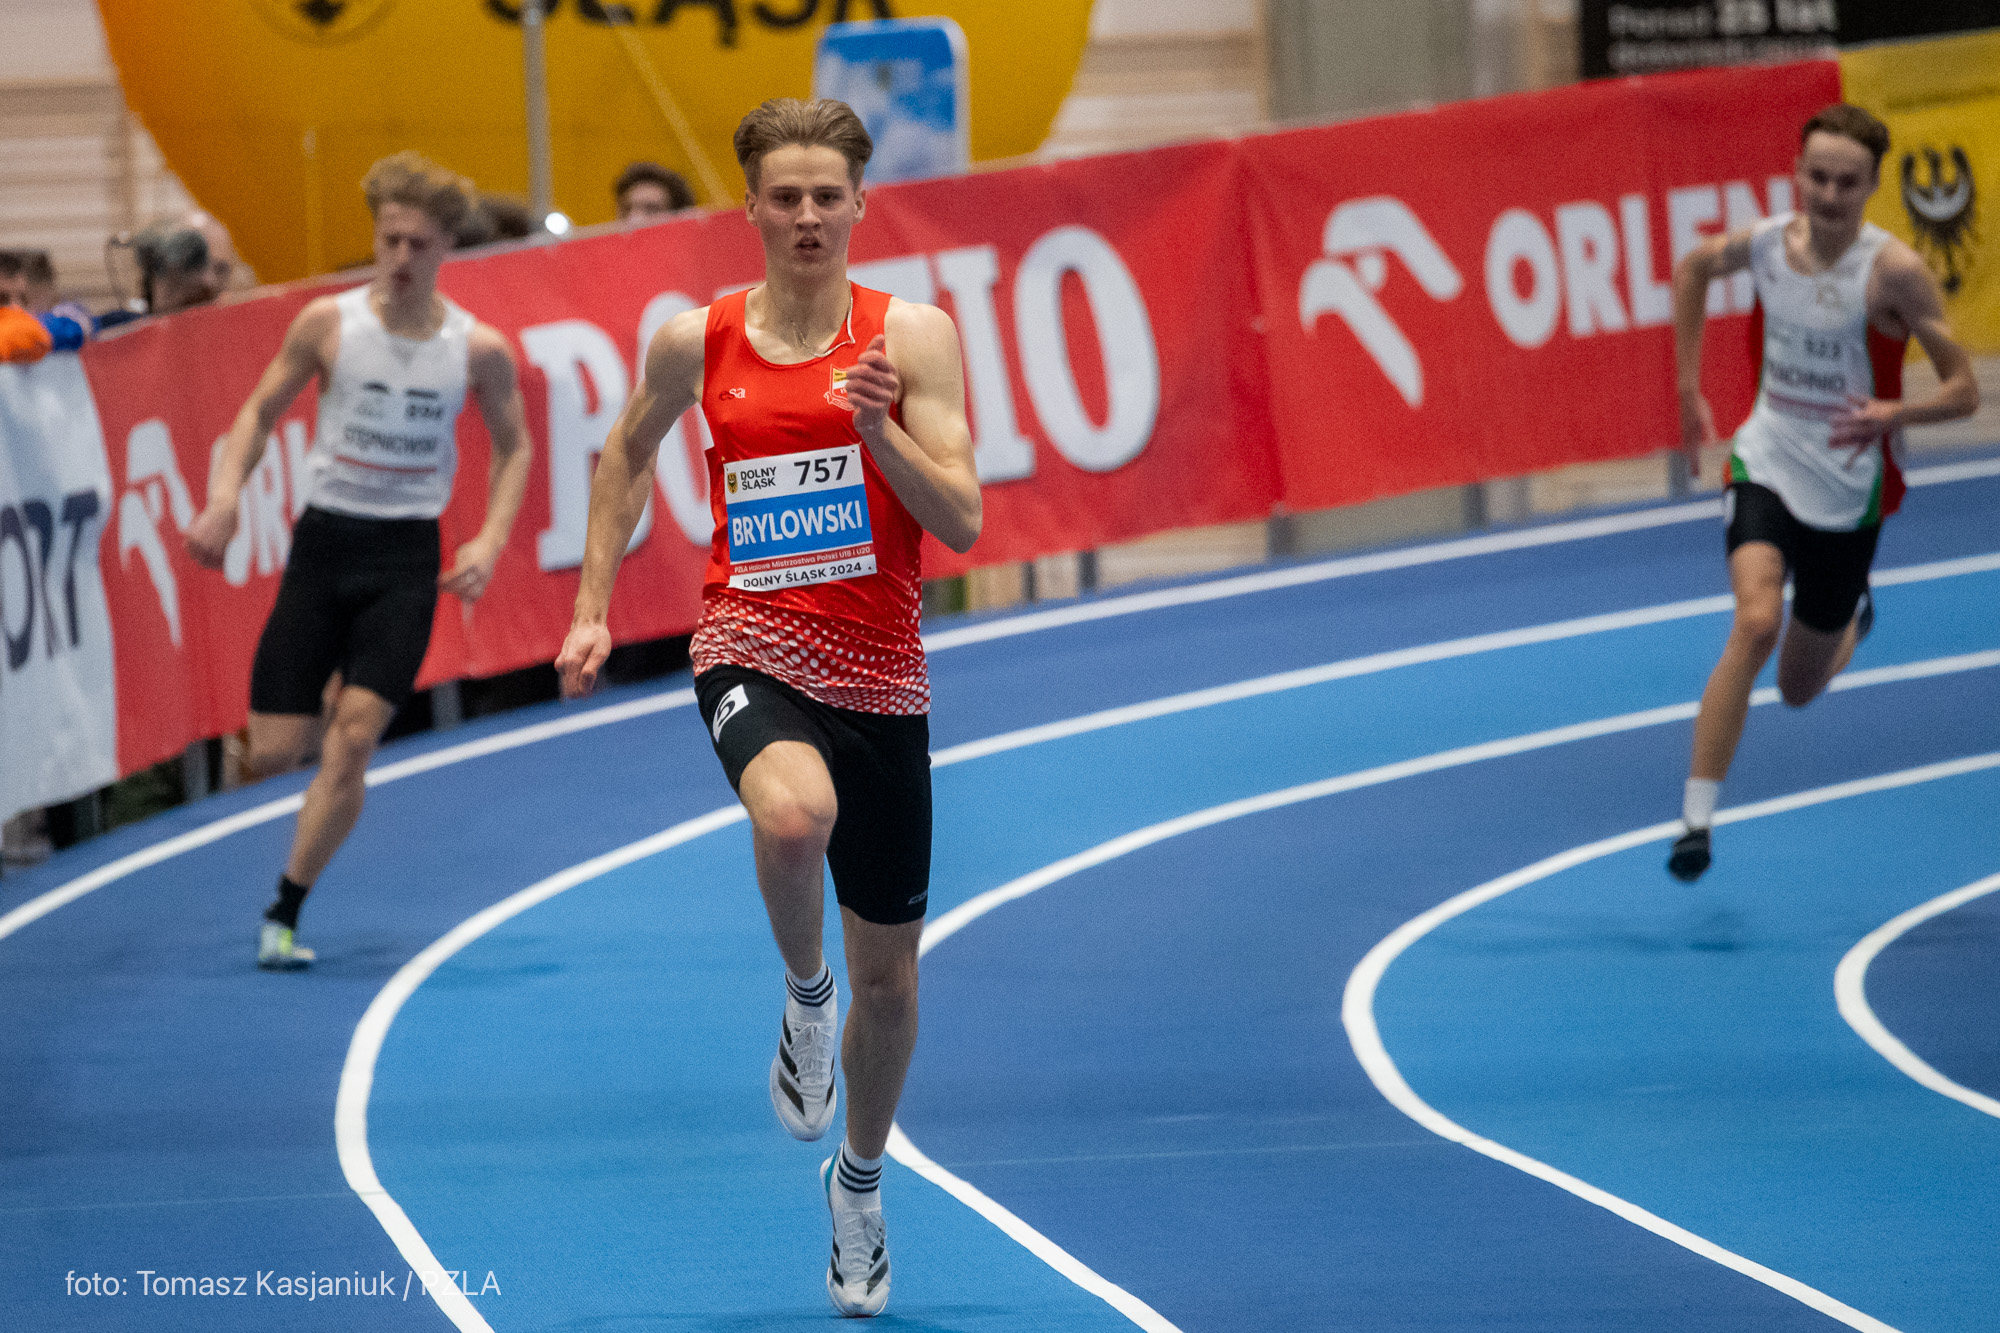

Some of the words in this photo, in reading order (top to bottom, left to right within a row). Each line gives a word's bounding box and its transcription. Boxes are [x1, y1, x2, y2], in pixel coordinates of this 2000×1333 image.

[740, 466, 777, 481] DOLNY
[741, 476, 777, 491] ŚLĄSK
[794, 455, 848, 486] 757
[732, 500, 863, 547] BRYLOWSKI
[734, 565, 748, 575] PZLA
[771, 556, 816, 569] Mistrzostwa
[816, 553, 839, 563] Polski
[838, 550, 852, 559] U18
[856, 546, 871, 556] U20
[743, 574, 782, 588] DOLNY
[785, 568, 827, 583] ŚLĄSK
[829, 562, 862, 576] 2024
